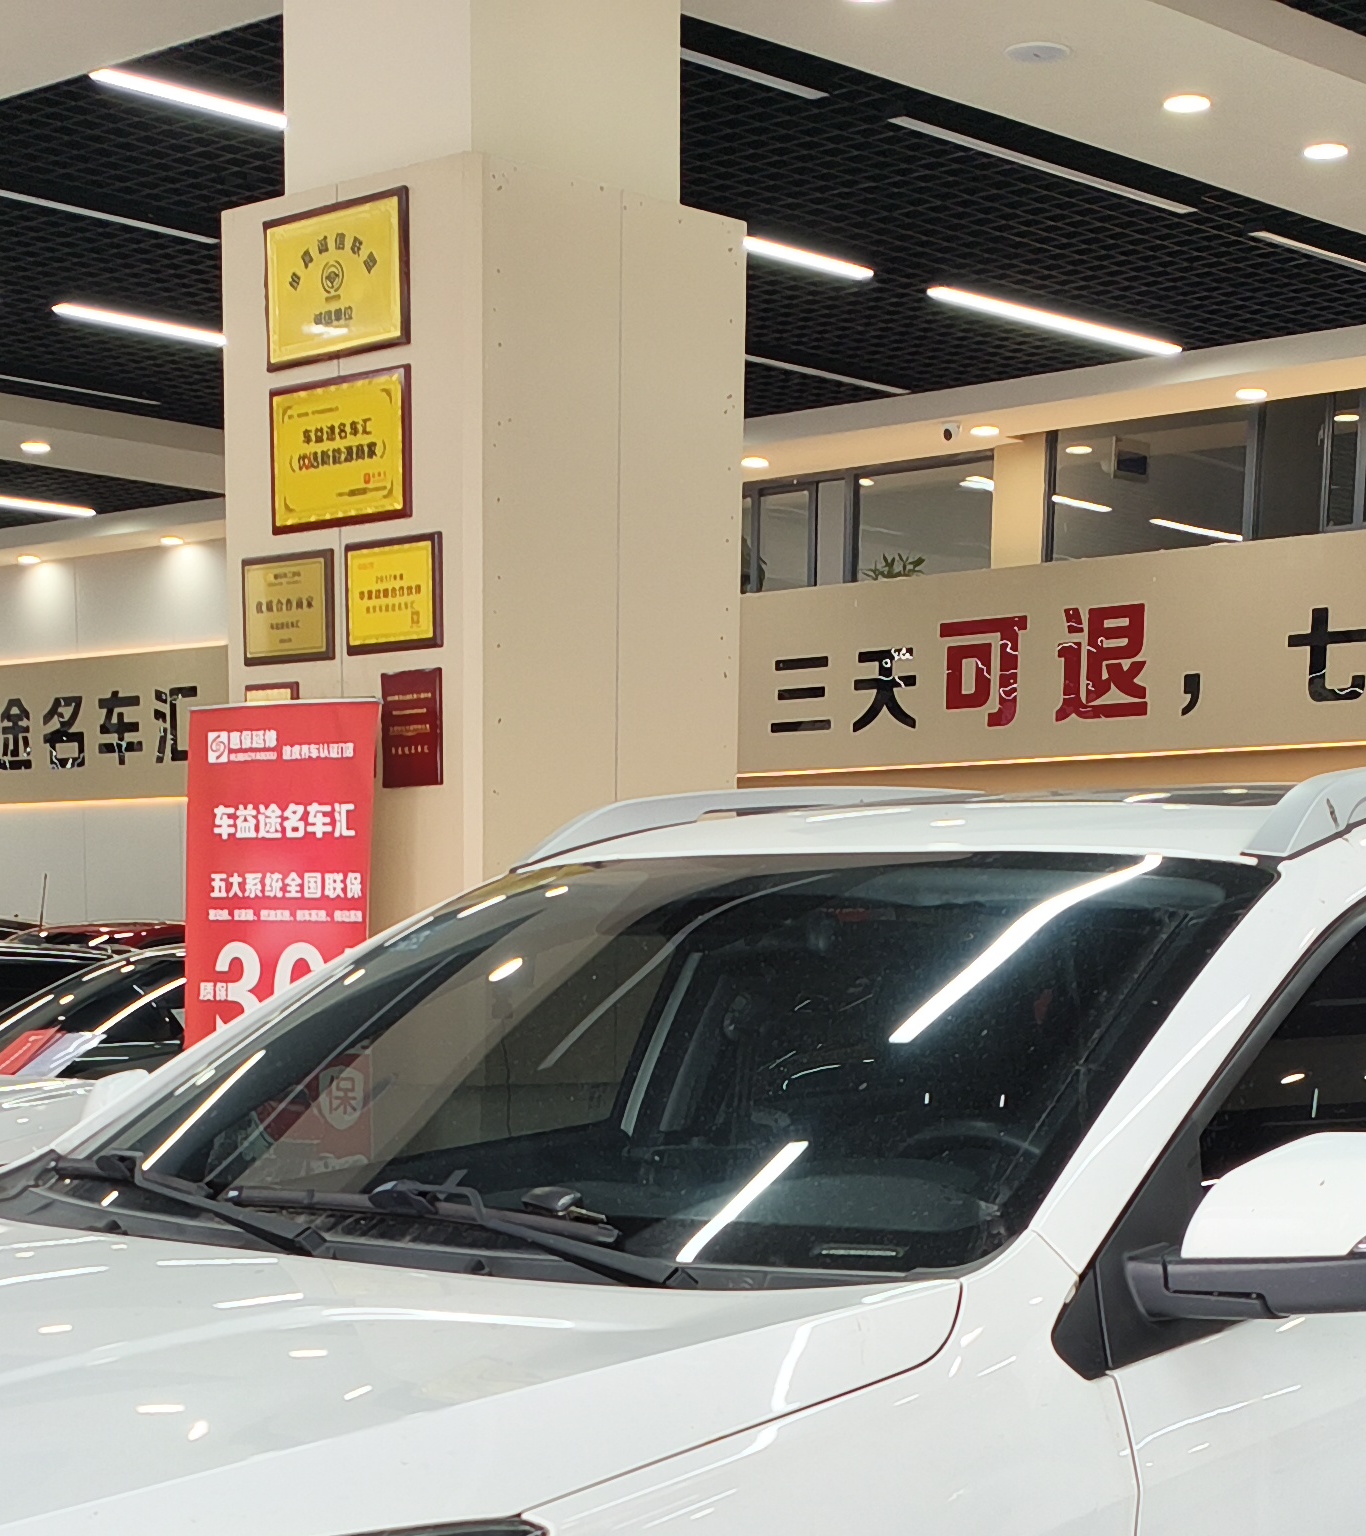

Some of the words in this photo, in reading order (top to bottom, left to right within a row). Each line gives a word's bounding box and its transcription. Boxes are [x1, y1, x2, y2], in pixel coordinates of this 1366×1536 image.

[213, 802, 356, 841] 车益途名车汇
[209, 872, 363, 899] 五大系统全国联保
[325, 1075, 358, 1115] 保
